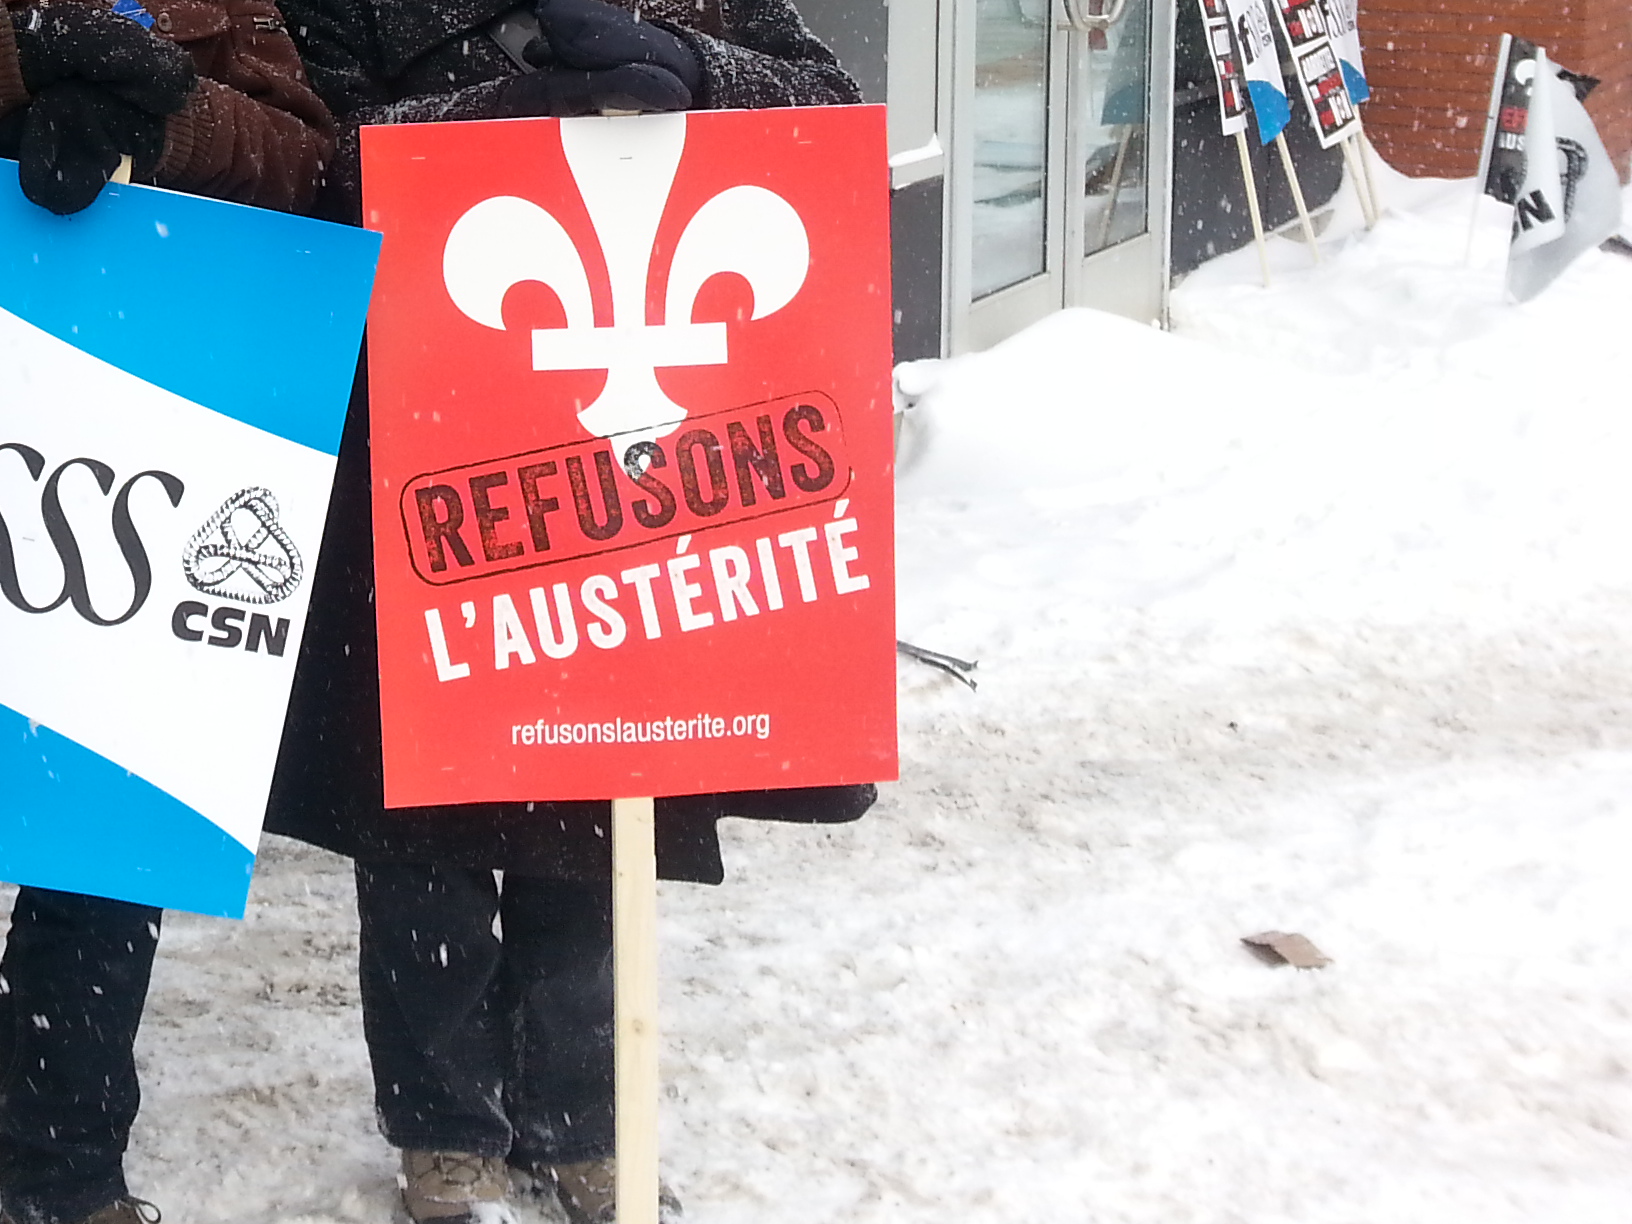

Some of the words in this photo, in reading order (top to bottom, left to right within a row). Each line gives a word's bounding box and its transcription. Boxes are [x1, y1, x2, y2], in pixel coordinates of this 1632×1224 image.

[414, 404, 836, 573] REFUSONS
[172, 599, 290, 657] CSN
[424, 498, 870, 683] L'AUSTÉRITÉ
[511, 713, 770, 746] refusonslausterite.org
